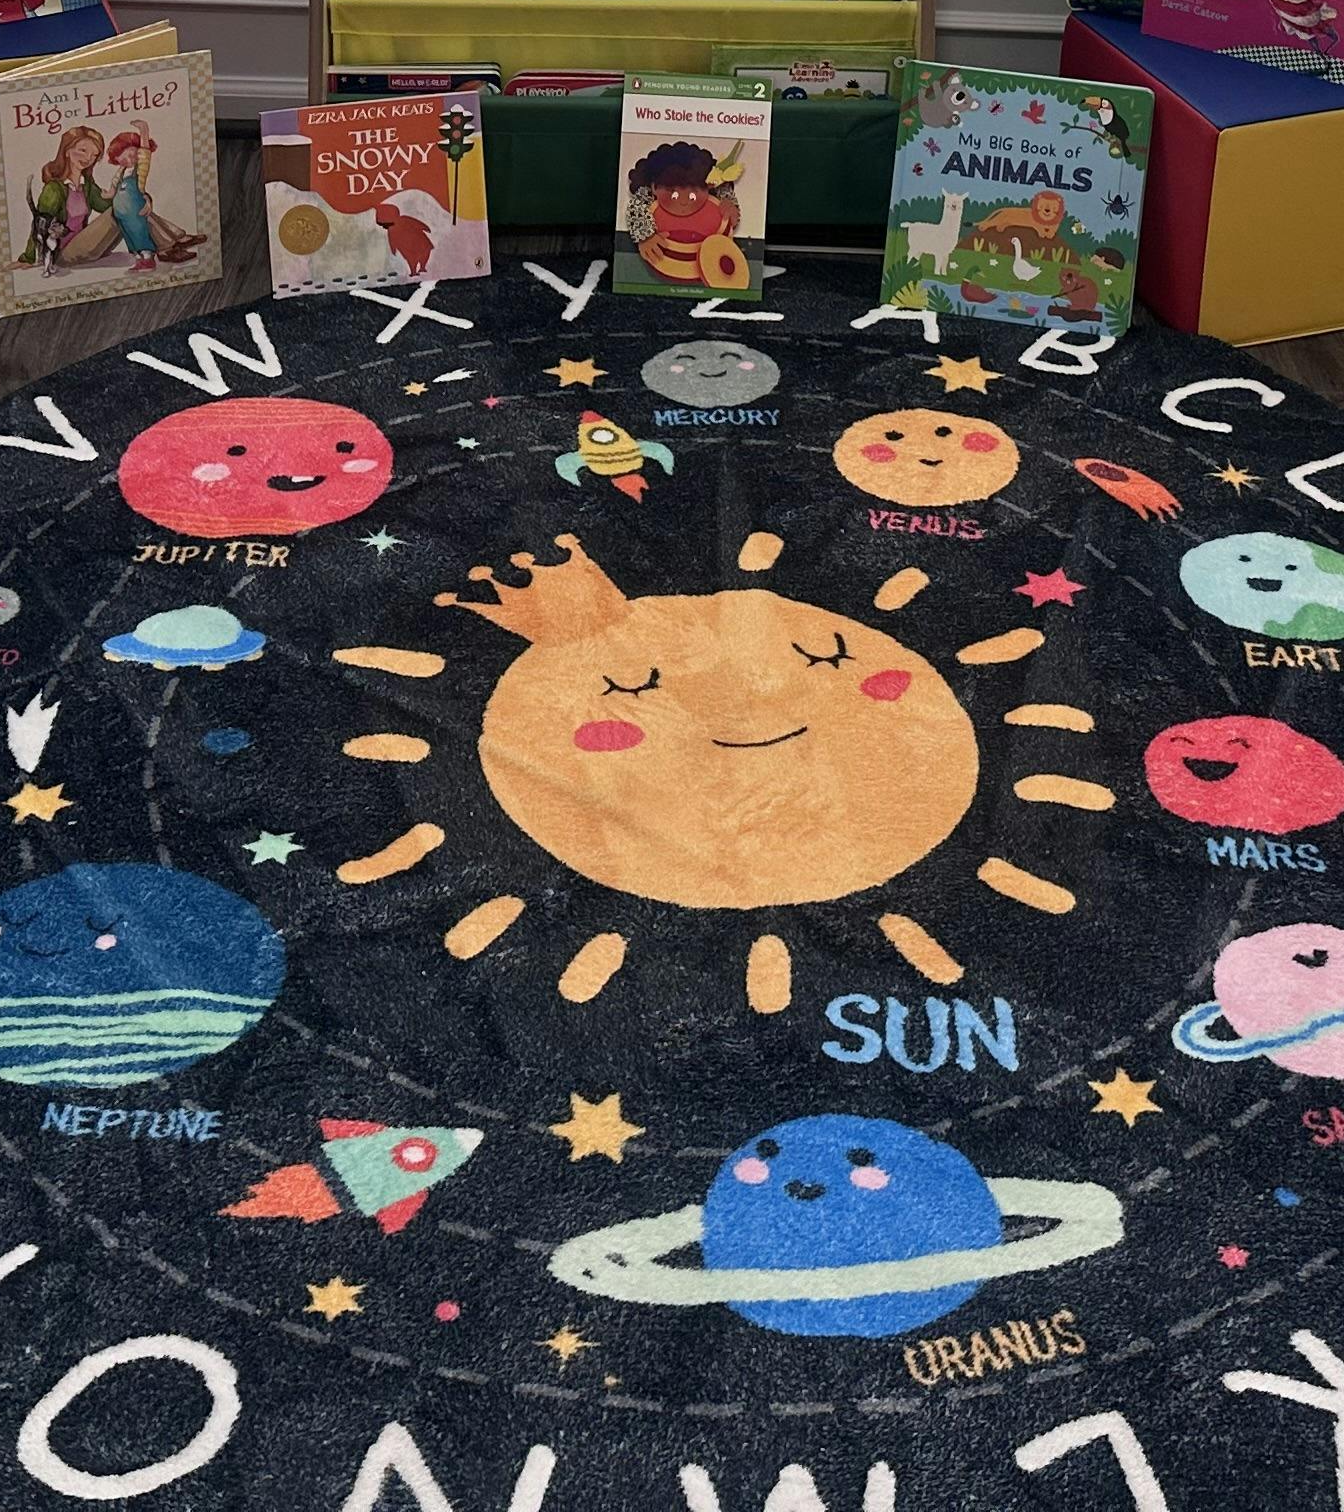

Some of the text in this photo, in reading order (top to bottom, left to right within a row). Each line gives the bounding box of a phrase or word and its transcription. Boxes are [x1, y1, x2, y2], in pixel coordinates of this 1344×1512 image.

[754, 82, 766, 98] 2
[789, 67, 835, 79] Learning
[13, 81, 178, 134] Big or Little?
[39, 88, 79, 106] Am I
[307, 101, 434, 125] EZRA JACK KEATS
[635, 107, 765, 126] Who Stole the Cookies?
[347, 127, 399, 146] THE
[959, 132, 1082, 159] My BIG Book of
[317, 142, 438, 174] SNOWY
[940, 151, 1093, 192] ANIMALS
[346, 169, 408, 197] DAY
[522, 259, 607, 320] Y
[350, 281, 473, 343] X
[126, 311, 285, 397] W
[1018, 329, 1115, 375] B
[652, 407, 780, 428] MERCURY
[1160, 377, 1286, 433] C
[867, 507, 985, 540] VENUS
[131, 541, 290, 569] JUPITER
[1207, 836, 1328, 874] MARS
[821, 992, 1020, 1073] SUN
[43, 1102, 222, 1143] NEPTUNE
[903, 1309, 1087, 1387] URANUS
[18, 1334, 241, 1500] O
